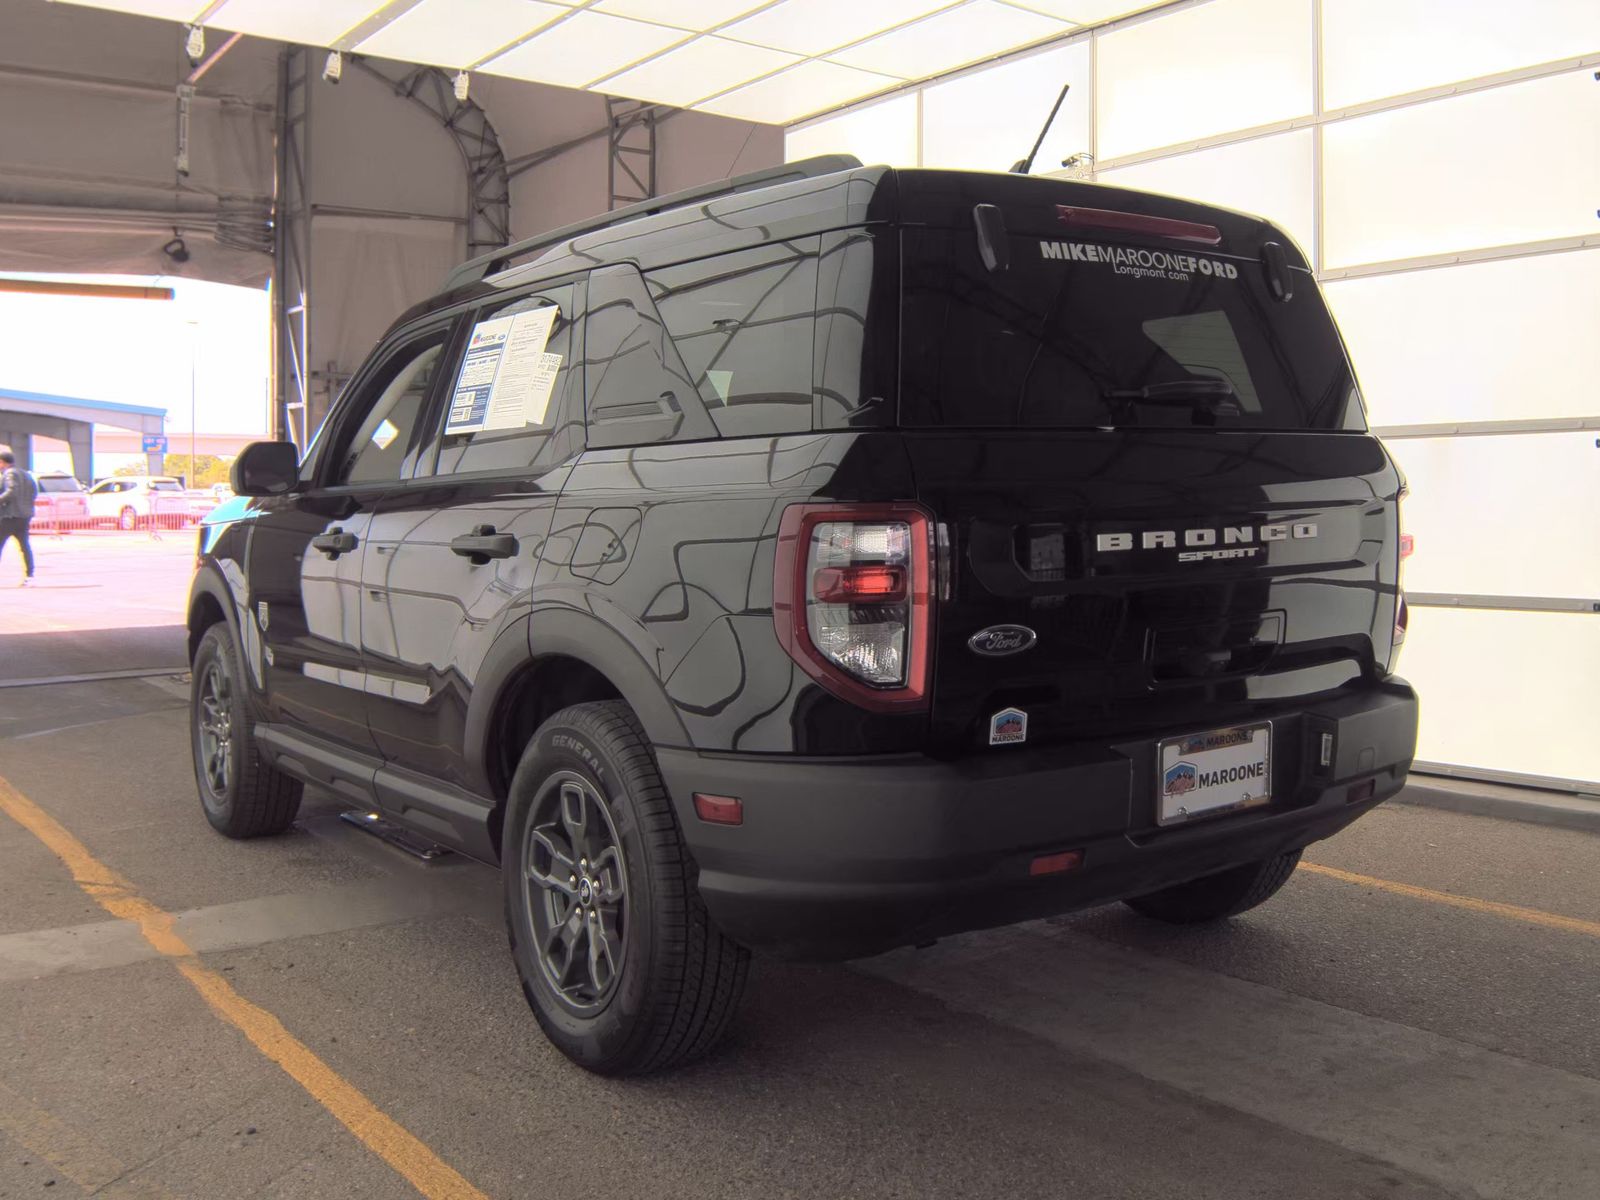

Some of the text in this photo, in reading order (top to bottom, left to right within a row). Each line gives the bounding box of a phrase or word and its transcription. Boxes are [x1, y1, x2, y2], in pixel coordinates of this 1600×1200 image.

[1114, 261, 1189, 281] Longmontcom
[1096, 523, 1318, 552] BRONCO
[1178, 547, 1259, 562] SPORT
[552, 735, 604, 781] GENERAL
[1198, 762, 1264, 789] MAROONE
